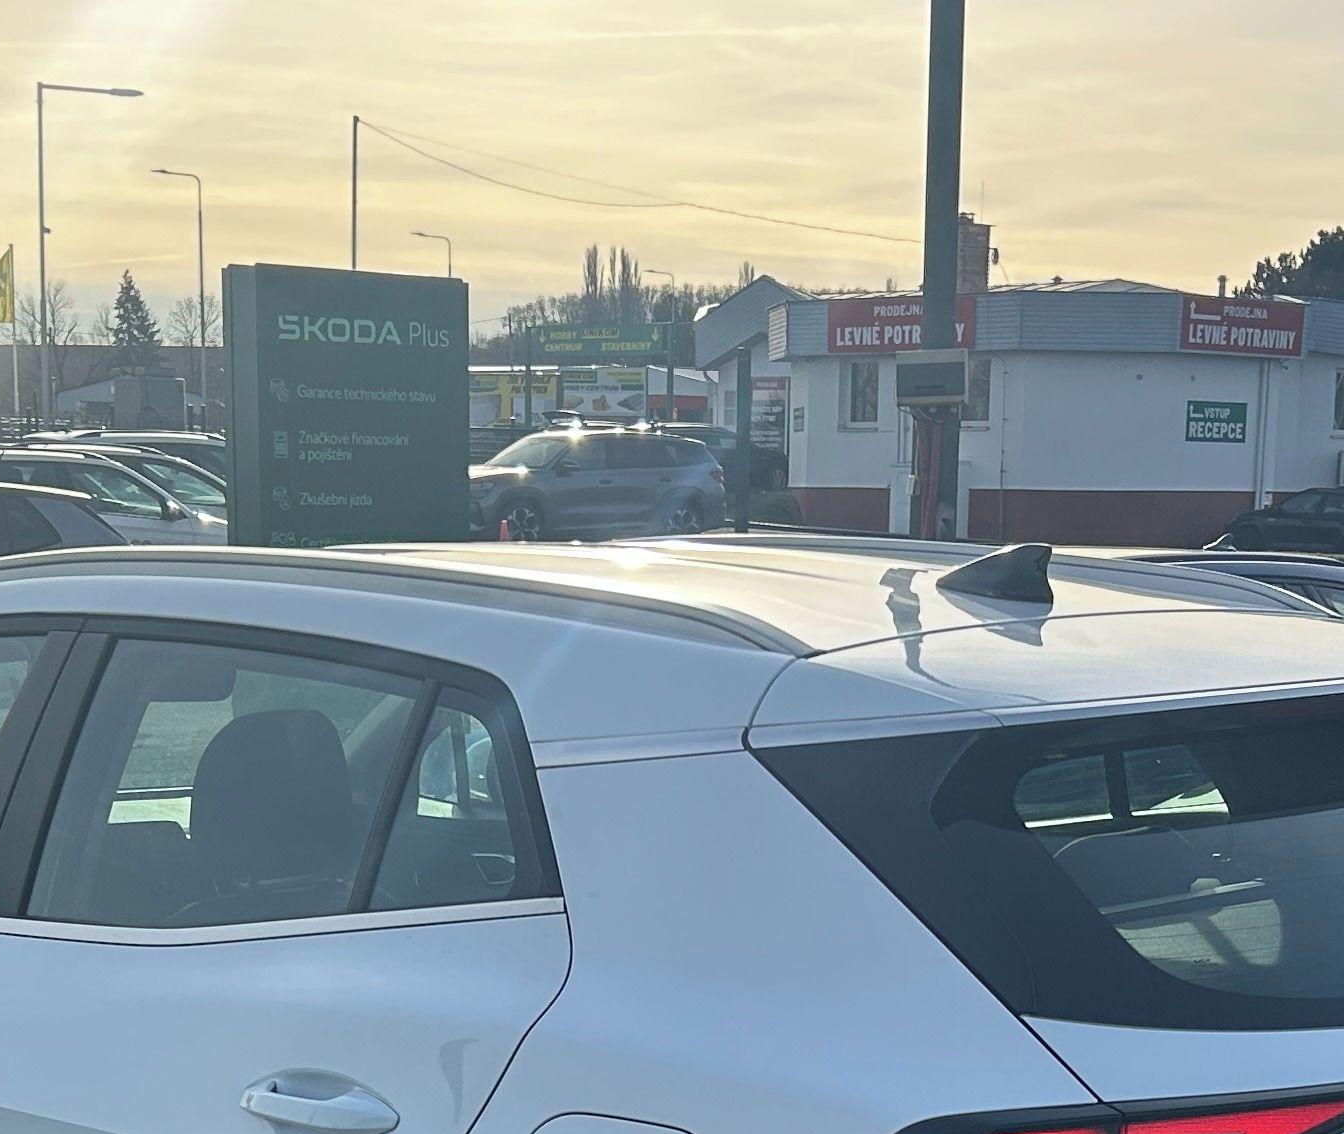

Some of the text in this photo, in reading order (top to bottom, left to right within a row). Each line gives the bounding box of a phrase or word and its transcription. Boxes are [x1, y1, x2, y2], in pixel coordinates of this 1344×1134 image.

[1223, 305, 1268, 319] PRODEJNA
[408, 321, 450, 348] Plus
[884, 323, 965, 345] POTRY
[1188, 321, 1296, 349] LEVNÉ POTRAVINY
[296, 384, 342, 400] Garance
[408, 391, 437, 403] stavu
[1204, 407, 1231, 419] VSTUP
[1188, 421, 1244, 439] RECEPCE
